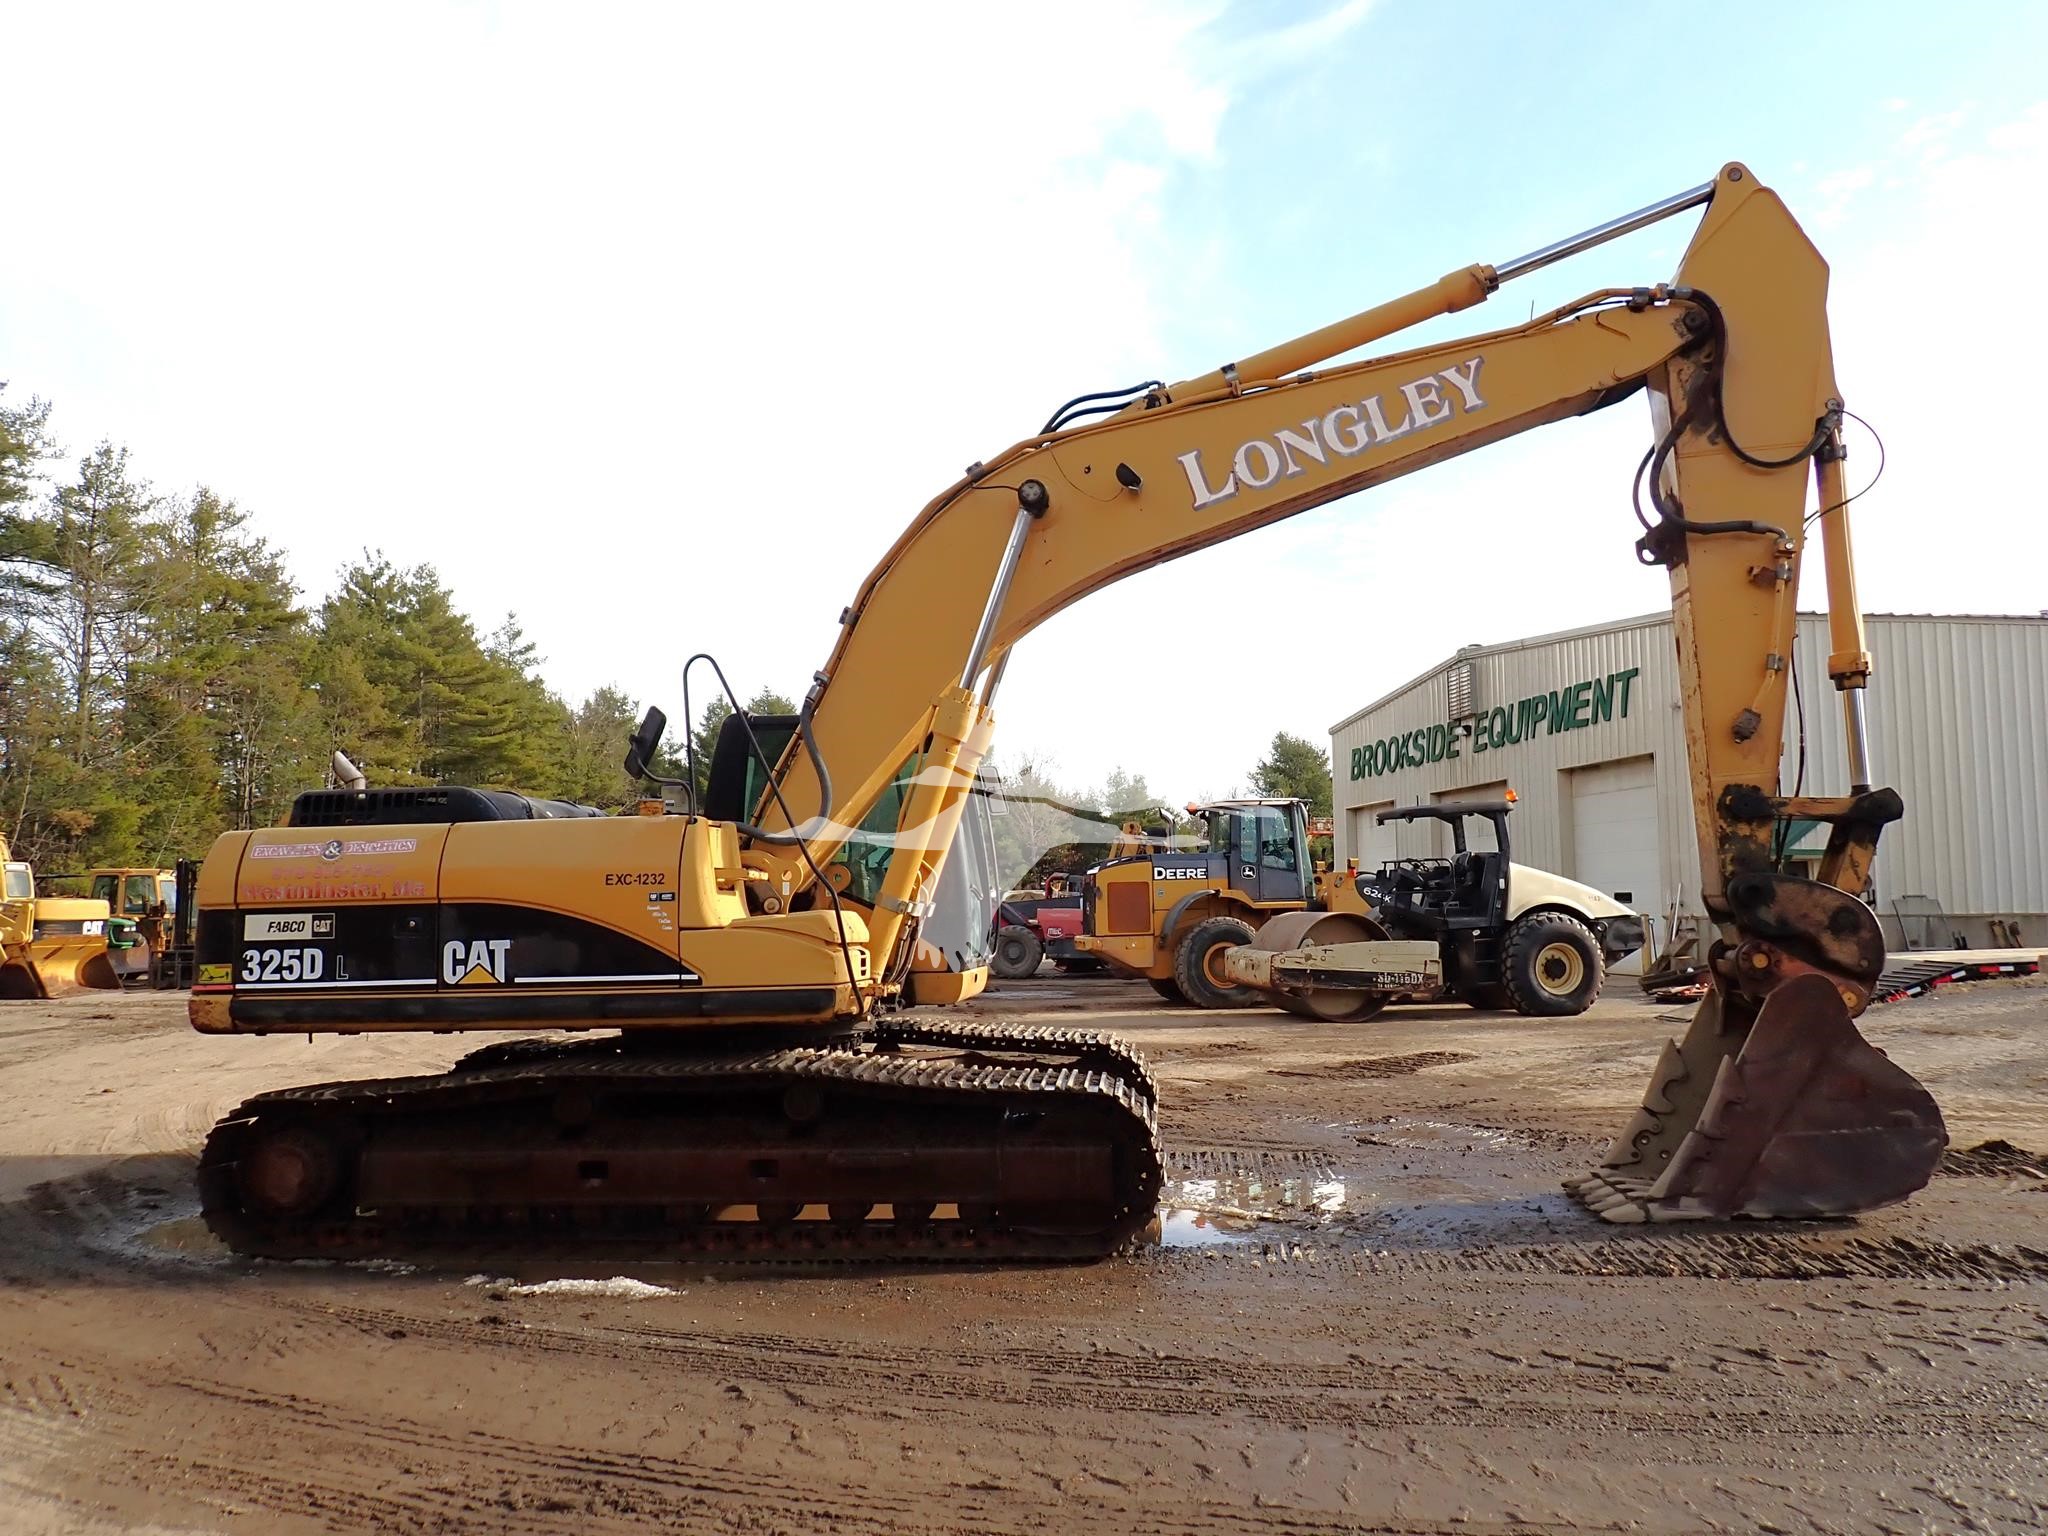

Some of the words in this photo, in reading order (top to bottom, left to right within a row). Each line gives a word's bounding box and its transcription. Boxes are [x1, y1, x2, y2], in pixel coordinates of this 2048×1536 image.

[1177, 356, 1485, 511] LONGLEY
[1350, 721, 1460, 781] BROOKSIDE
[1473, 667, 1639, 753] EQUIPMENT
[254, 845, 321, 857] EXCAVION
[324, 841, 342, 857] &
[605, 873, 665, 886] EXC-1232
[1153, 867, 1207, 880] DEERE
[82, 921, 104, 935] CAT
[267, 921, 305, 933] FABCO
[313, 919, 333, 932] CAT
[242, 948, 323, 981] 325D
[336, 955, 349, 980] L
[443, 939, 511, 984] CAT
